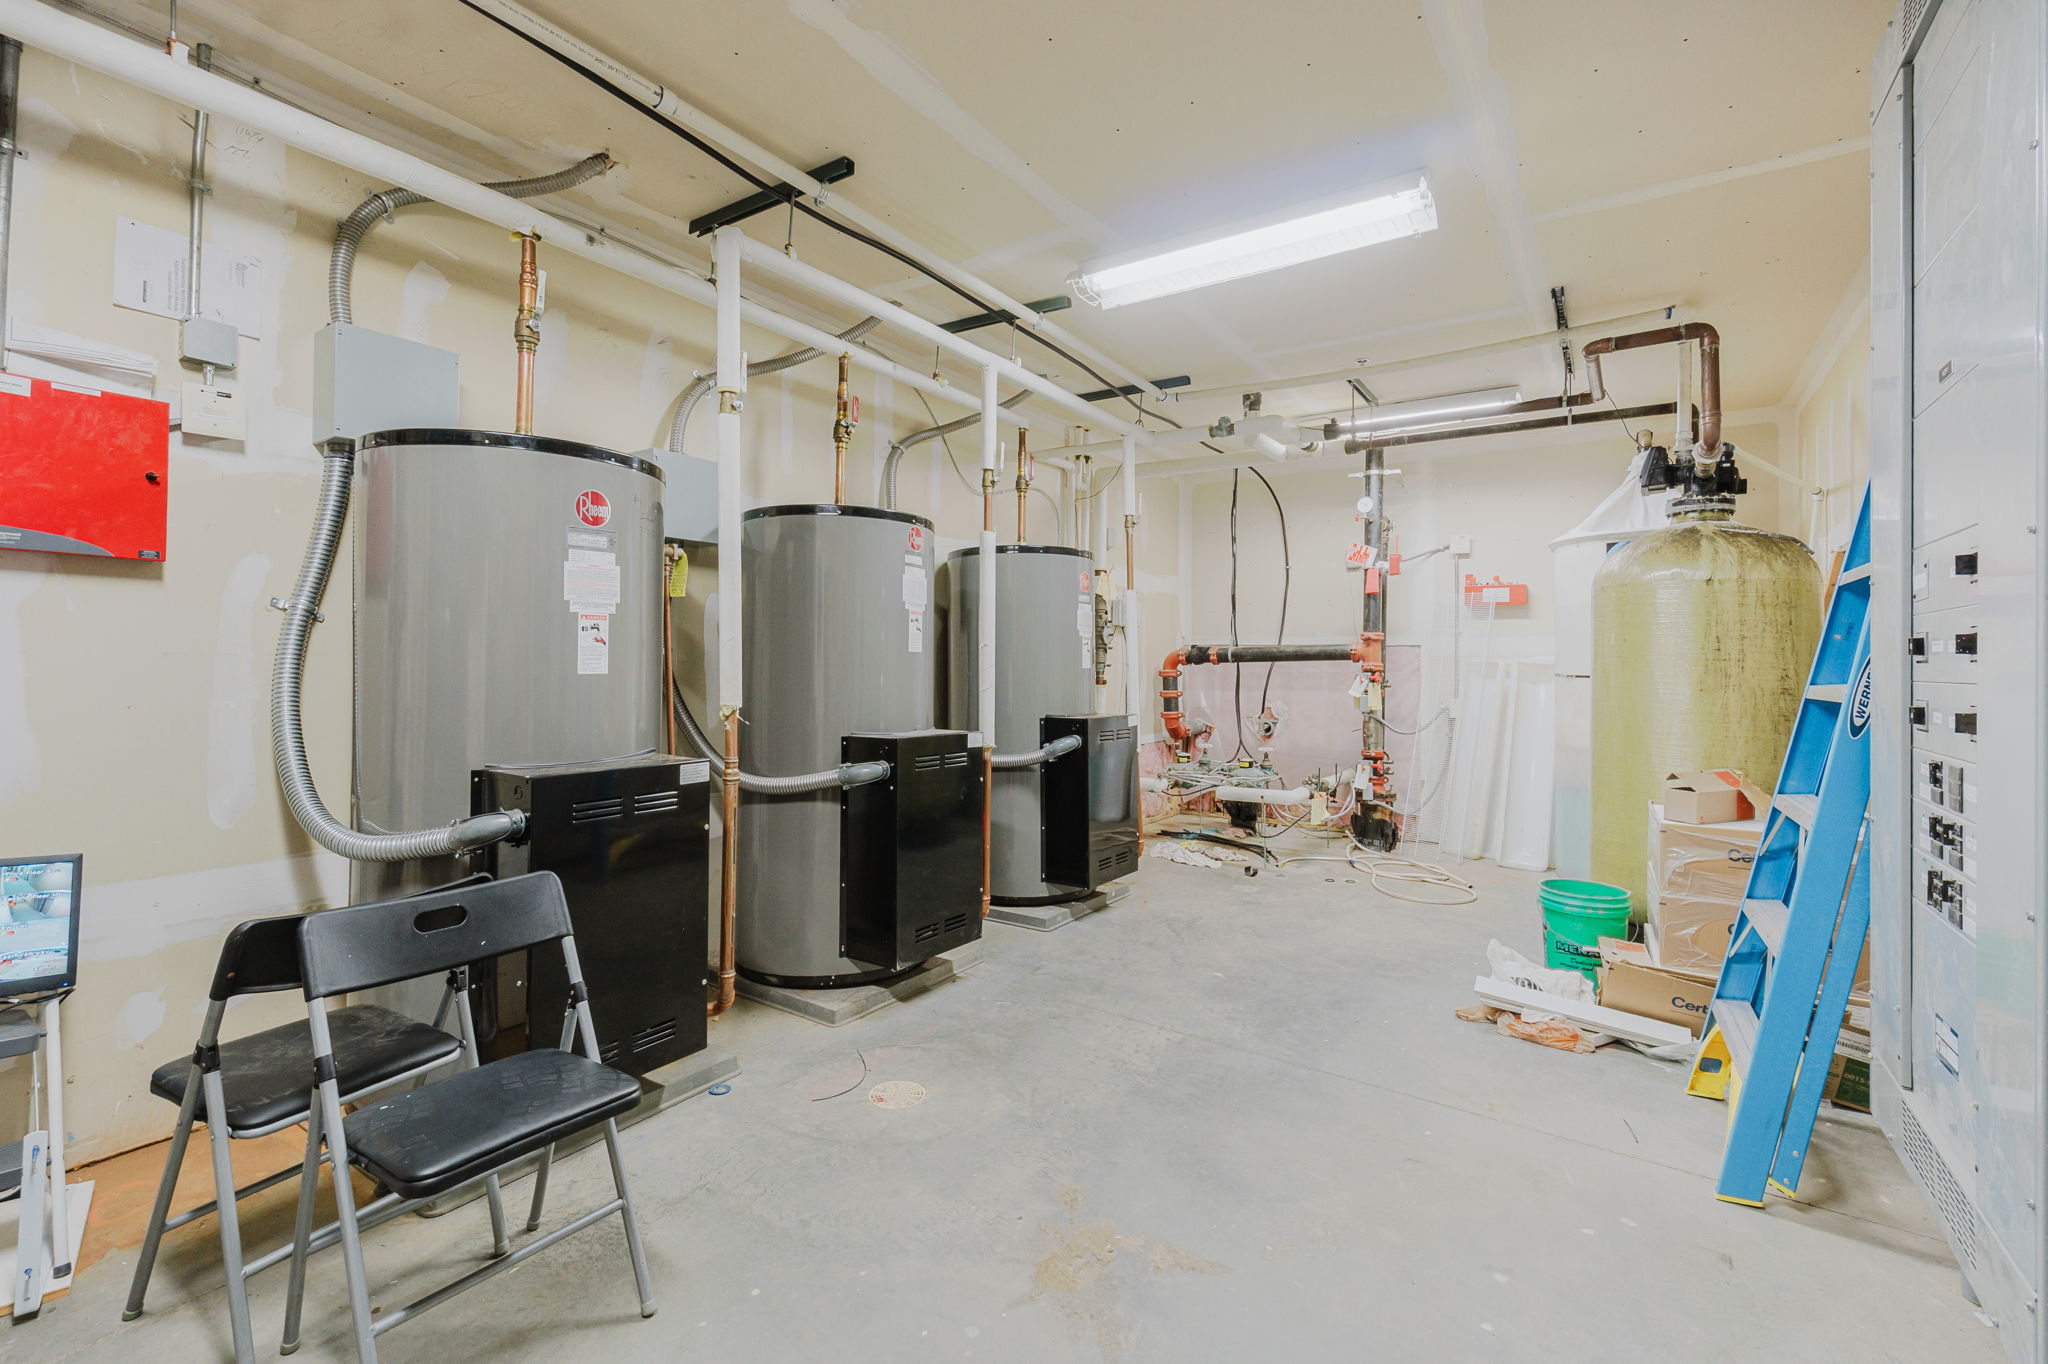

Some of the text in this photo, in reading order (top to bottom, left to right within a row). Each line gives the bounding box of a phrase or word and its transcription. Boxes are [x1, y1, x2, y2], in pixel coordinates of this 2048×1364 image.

[580, 490, 609, 521] Rheem
[1855, 667, 1870, 719] WERN
[1671, 996, 1709, 1015] Cert
